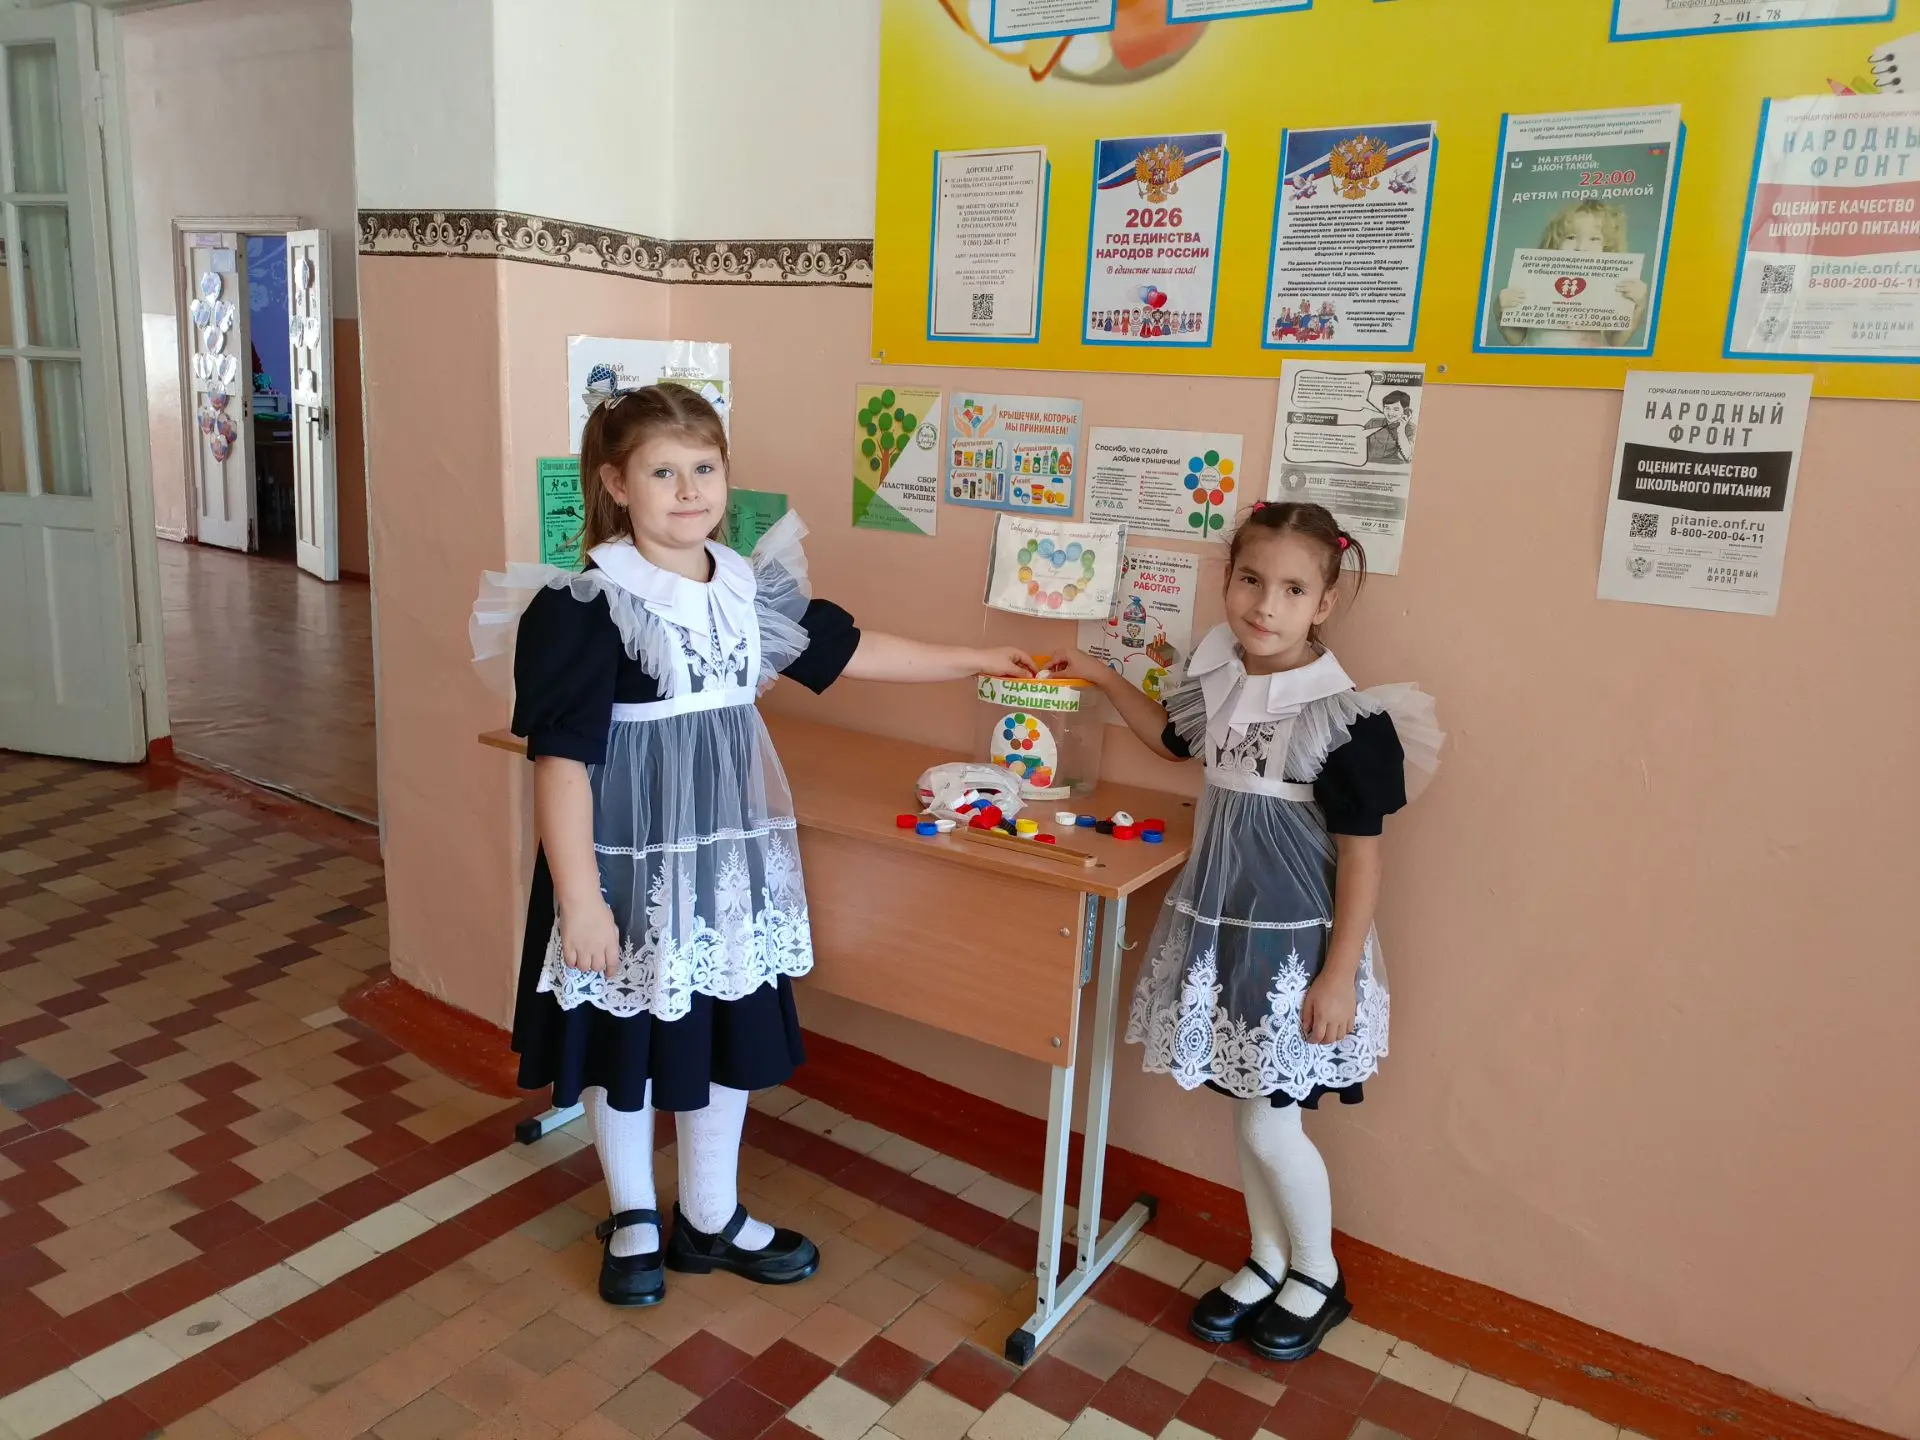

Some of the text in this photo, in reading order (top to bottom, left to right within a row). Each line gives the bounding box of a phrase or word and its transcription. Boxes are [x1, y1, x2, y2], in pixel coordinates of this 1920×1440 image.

[1713, 13, 1720, 24] 2
[1736, 10, 1751, 22] 01
[1767, 8, 1781, 20] 78
[1553, 153, 1593, 163] КУБАНИ
[1531, 161, 1599, 172] ЗАКОН ТАКОЙ:
[1811, 154, 1910, 178] ФРОНТ
[1579, 169, 1636, 186] 22:00
[1512, 184, 1653, 203] детям пора домой
[1772, 198, 1915, 218] ОЦЕНИТЕ КАЧЕСТВО
[1125, 207, 1183, 228] 2026
[1768, 221, 1858, 237] ШКОЛЬНОГО
[1106, 232, 1201, 245] ГОД ЕДИНСТВА
[1096, 248, 1209, 260] НАРОДОВ РОССИИ
[1534, 255, 1594, 263] сопровождения
[1106, 266, 1113, 274] В
[1115, 265, 1150, 275] единстве
[1175, 266, 1196, 274] сила!
[1810, 261, 1920, 277] pitanie.onf.ru
[1808, 277, 1920, 289] 8-800-200-04-11
[660, 365, 667, 377] 1
[999, 411, 1077, 424] КРЫШЕЧКИ, КОТОРЫЕ
[1645, 401, 1784, 424] НАРОДНЫЙ
[1004, 422, 1069, 435] МЫ ПРИНИМАЕМ!
[1668, 424, 1753, 447] ФРОНТ
[1095, 443, 1128, 453] Спасибо,
[1113, 454, 1181, 466] добрые крышечки!
[1637, 460, 1758, 479] ОЦЕНИТЕ КАЧЕСТВО
[917, 476, 937, 484] СБОР
[882, 481, 936, 493] ПЛАСТИКОВЫХ
[1635, 477, 1771, 499] ШКОЛЬНОГО ПИТАНИЯ
[902, 492, 936, 502] КРЫШЕК
[1671, 514, 1765, 532] pitanie.onf.ru
[1670, 527, 1764, 543] 8-800-200-04-11
[1140, 572, 1176, 584] КАК ЭТО
[1708, 566, 1758, 578] НАРОДНЫЙ
[1707, 575, 1738, 584] ФРОНТ
[1133, 581, 1181, 594] РАБОТАЕТ?
[1001, 693, 1079, 711] КРЫШЕЧКИ
